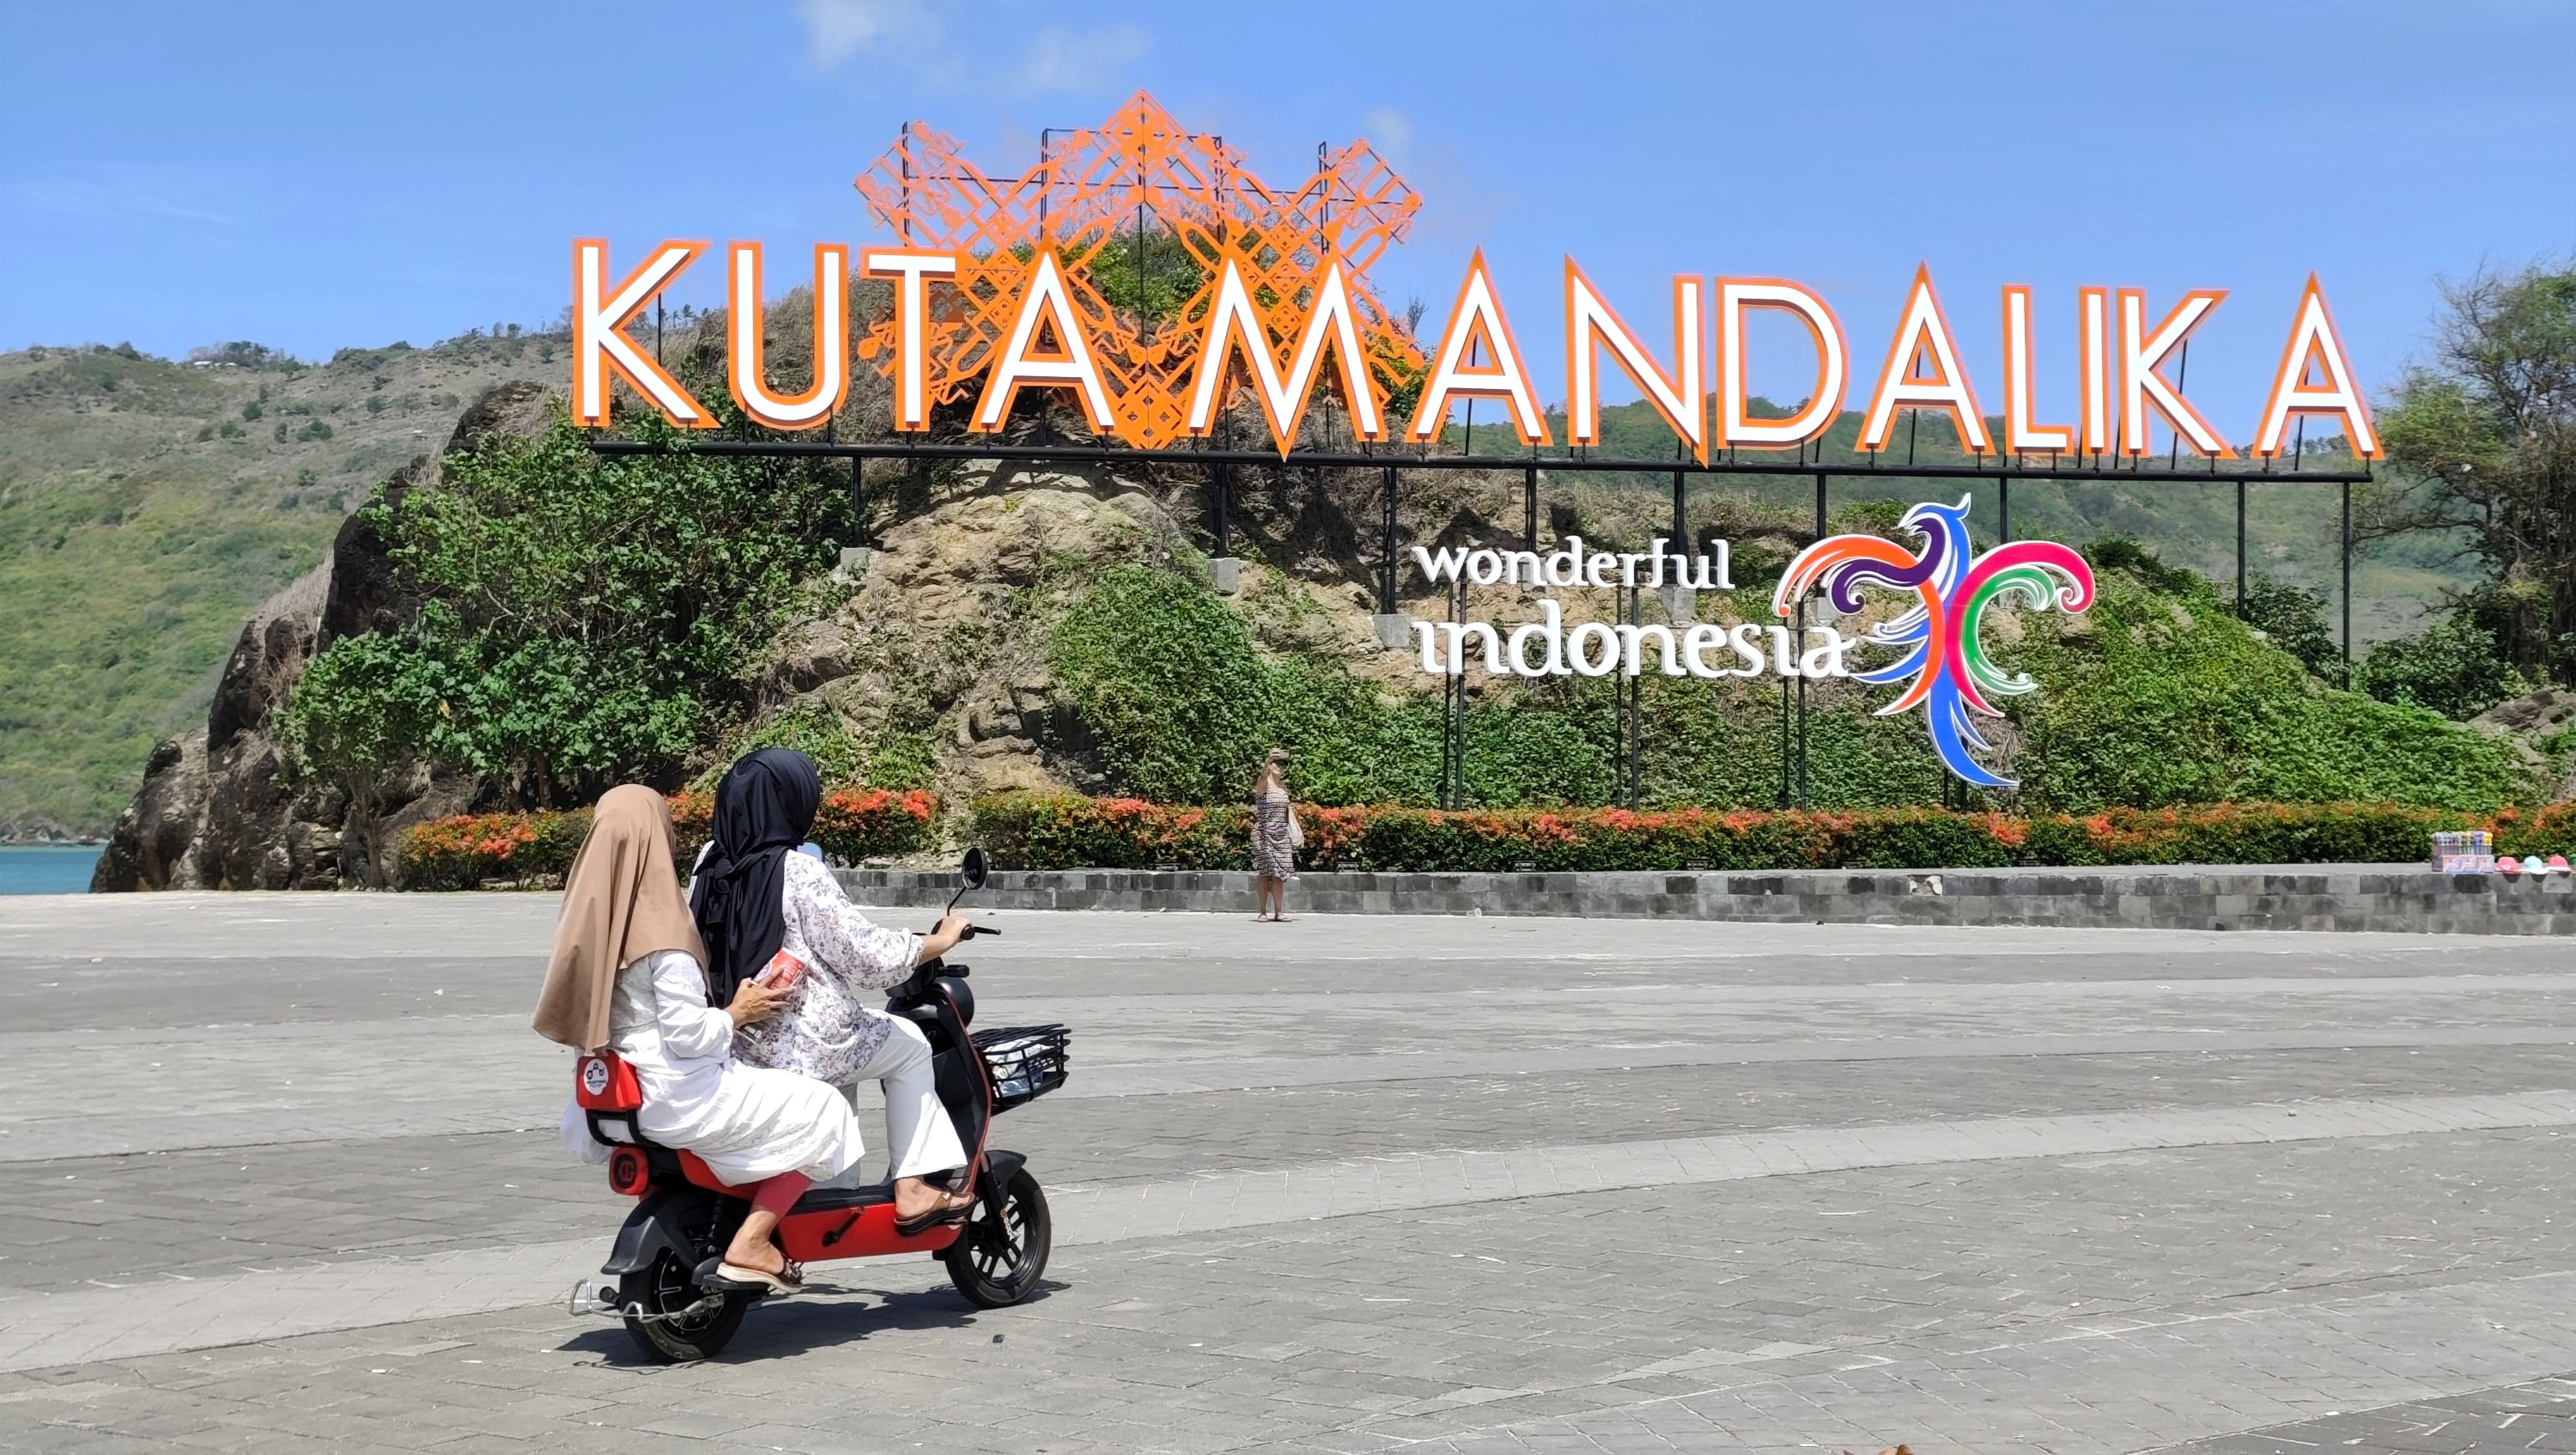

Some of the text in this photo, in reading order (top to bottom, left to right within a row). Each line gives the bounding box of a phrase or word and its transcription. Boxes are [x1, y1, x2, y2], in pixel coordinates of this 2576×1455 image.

[572, 237, 2385, 468] KUTA MANDALIKA
[1411, 535, 1735, 590] wonderful
[1411, 599, 1857, 679] indonesia
